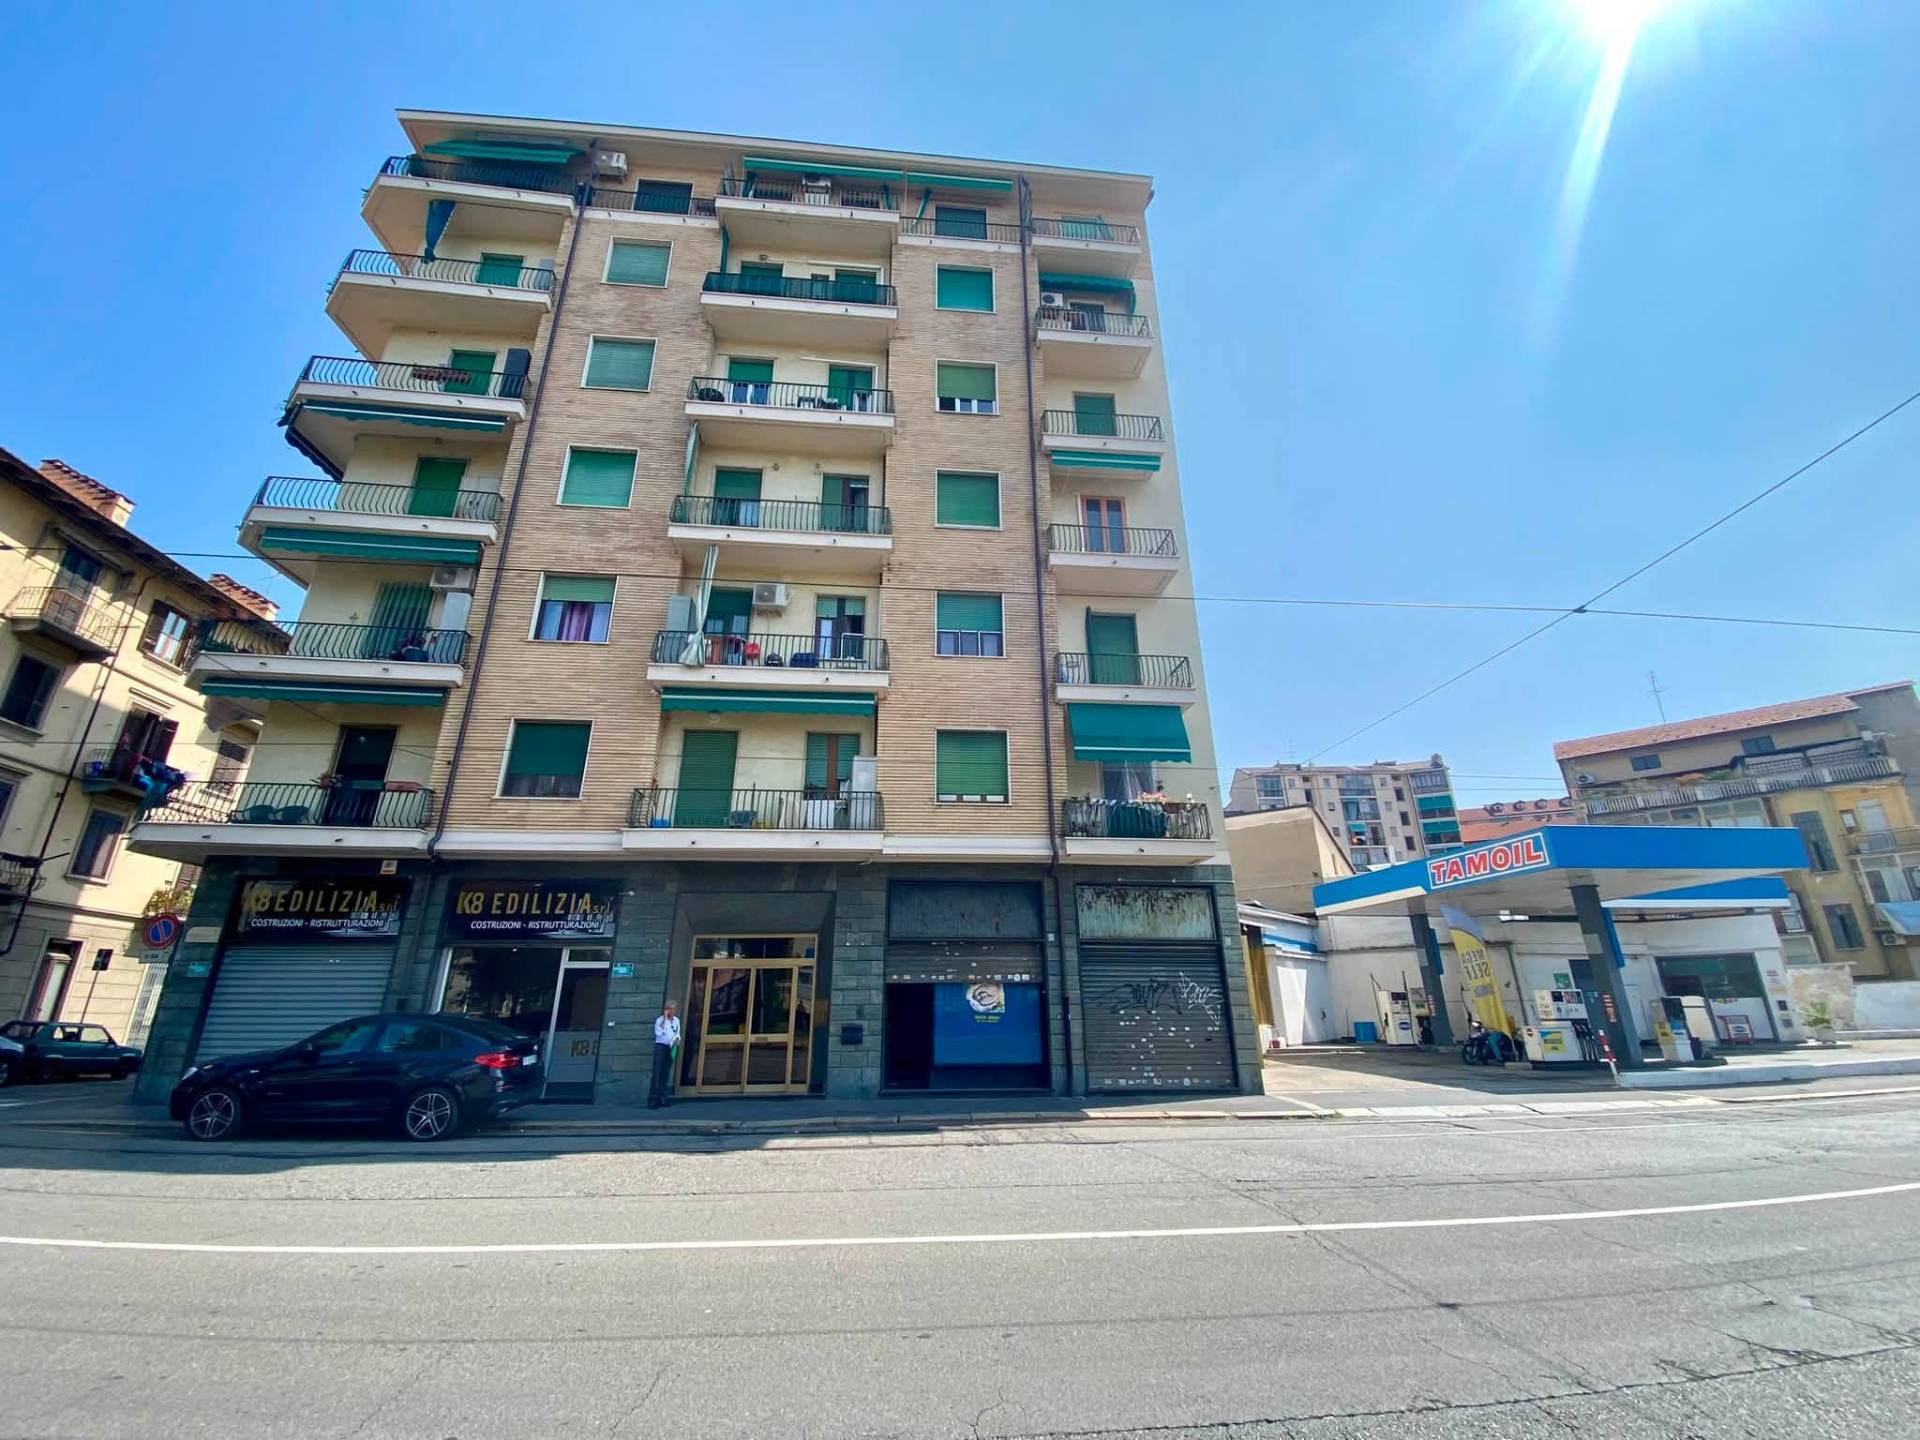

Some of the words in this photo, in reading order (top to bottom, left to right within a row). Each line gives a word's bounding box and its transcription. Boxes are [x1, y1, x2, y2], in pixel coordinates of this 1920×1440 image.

[1431, 839, 1544, 884] TAMOIL
[274, 890, 377, 912] EDILIZIA
[456, 892, 485, 914] K8
[491, 892, 591, 914] EDILIZIA
[251, 919, 304, 928] COSTRUZIONI
[310, 919, 384, 928] RISTRUTTURAZIONI
[471, 920, 522, 929] COSTRUZIONI
[528, 920, 601, 929] RISTRUTTURAZIONI
